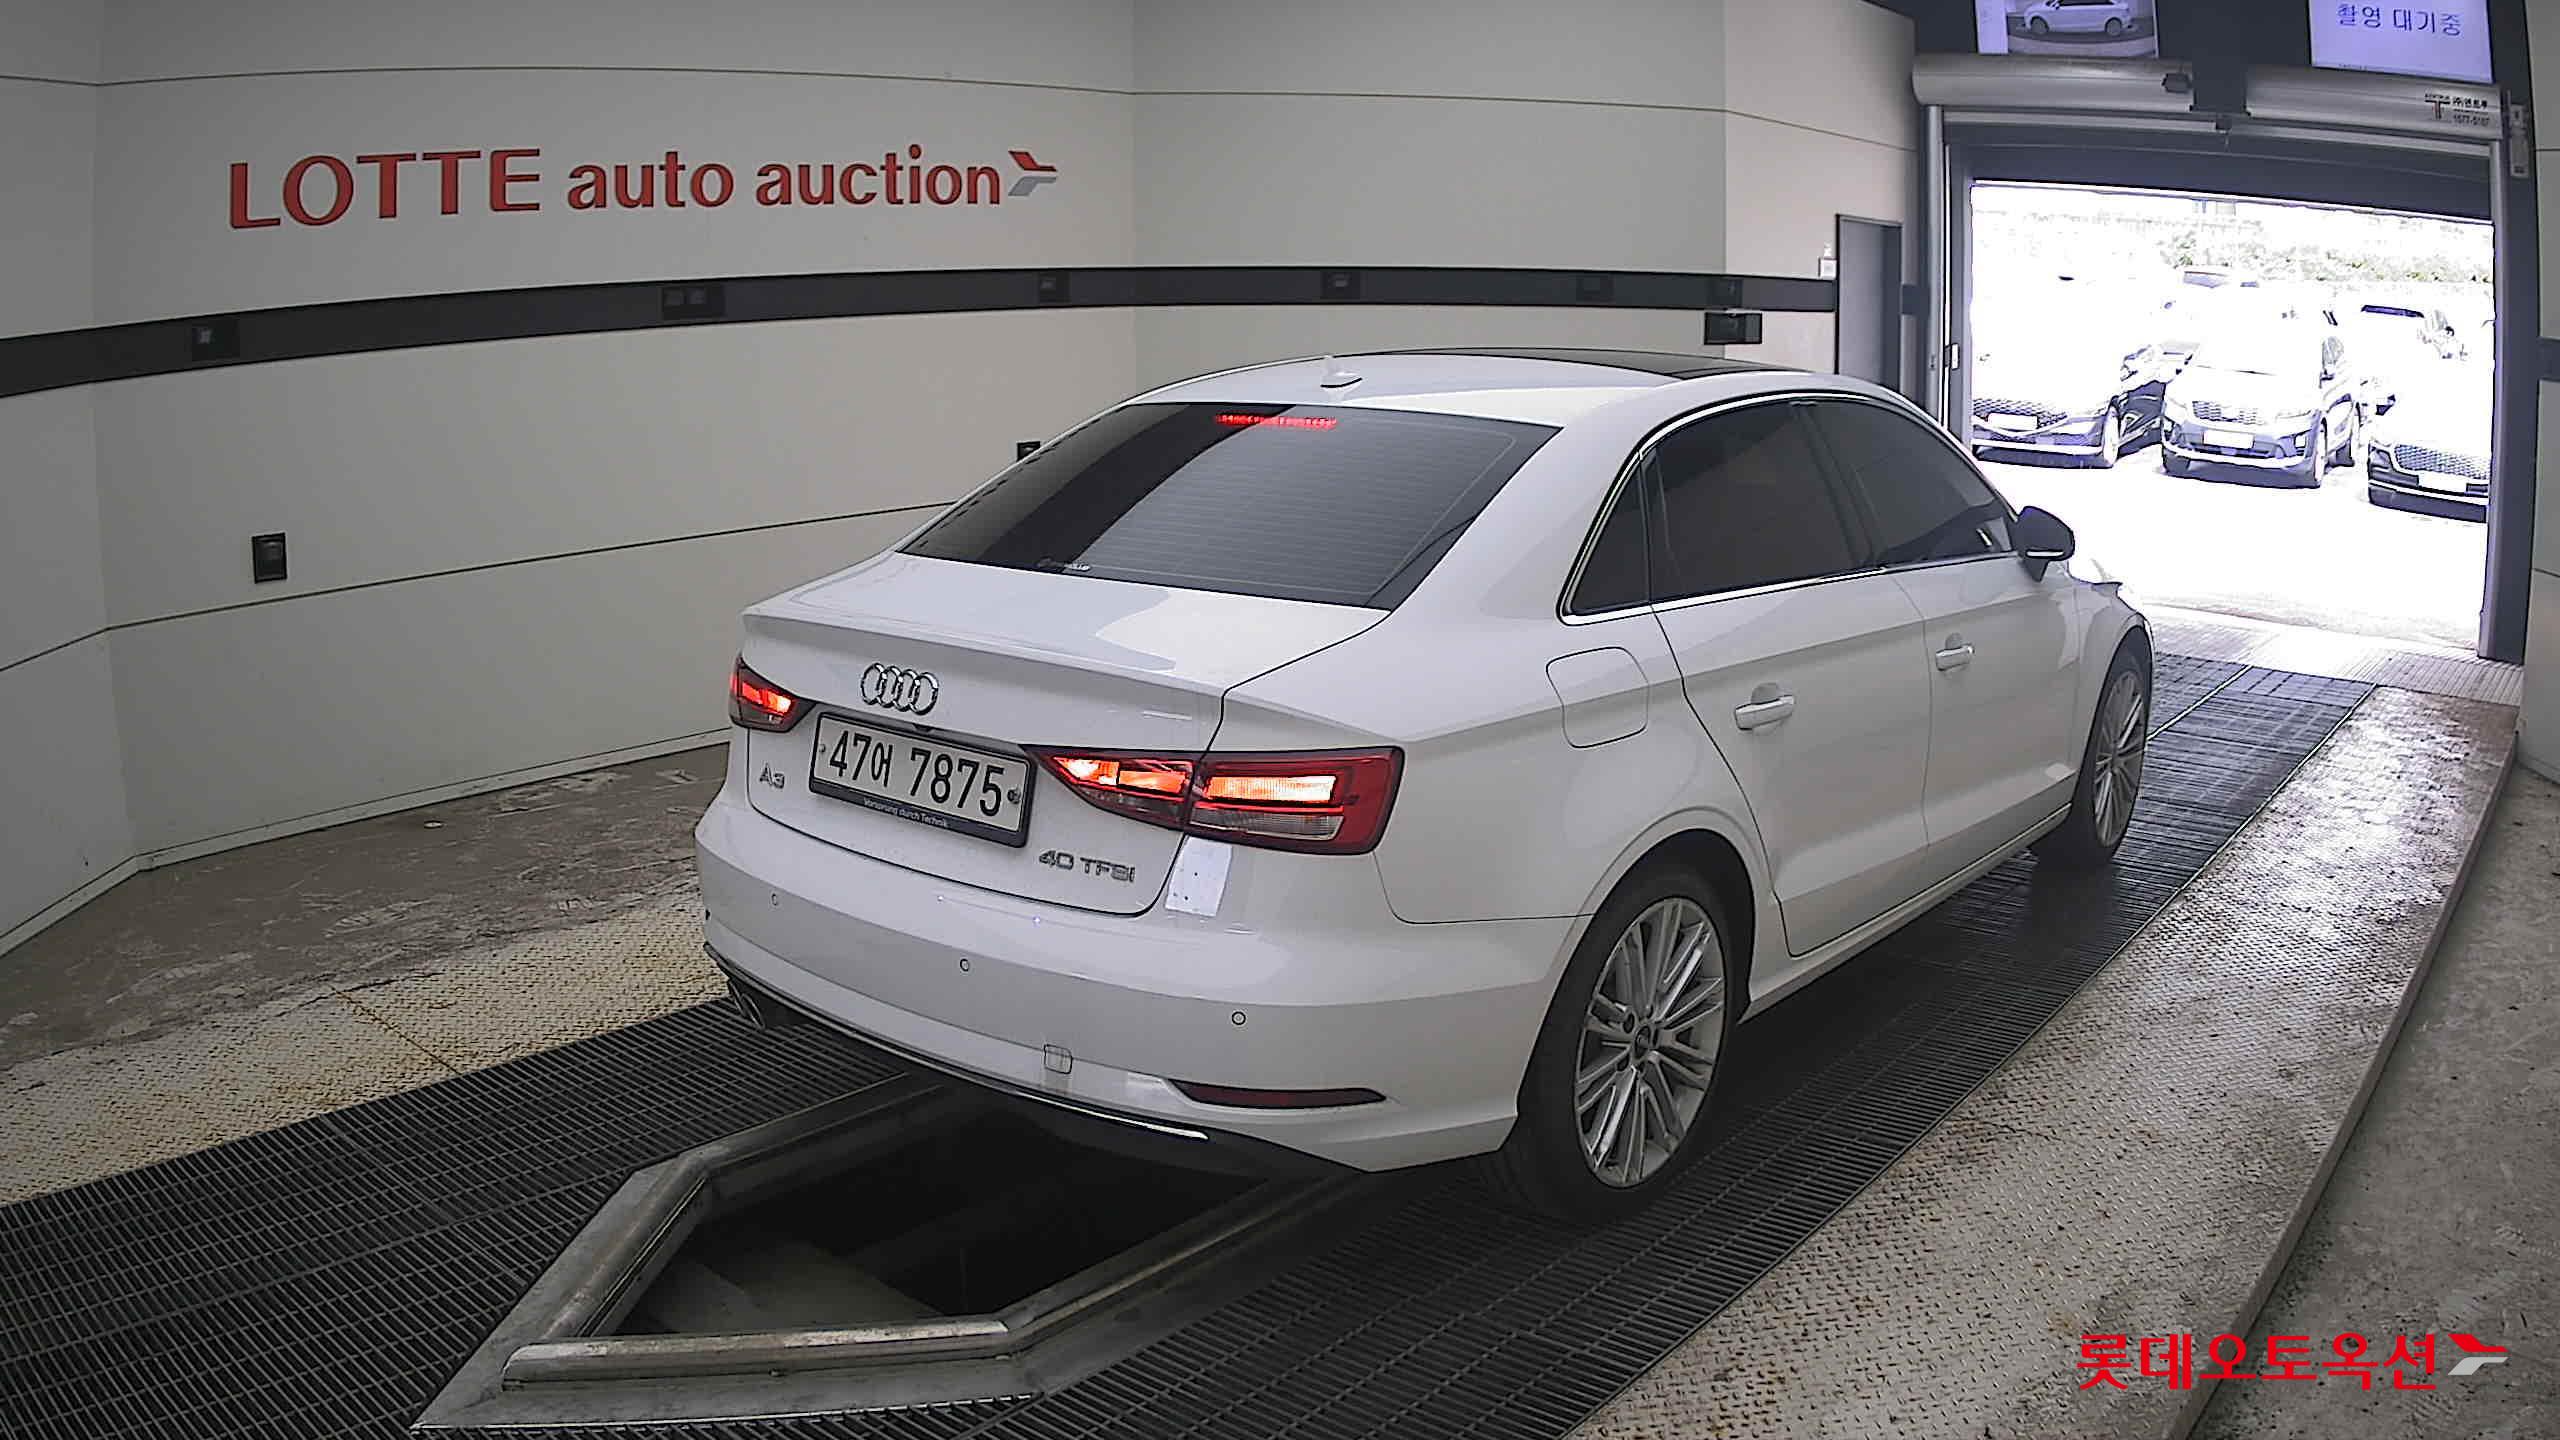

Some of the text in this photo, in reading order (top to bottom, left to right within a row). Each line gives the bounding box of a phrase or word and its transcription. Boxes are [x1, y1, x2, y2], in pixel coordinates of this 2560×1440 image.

[2338, 3, 2462, 37] 촬영 대기중
[229, 143, 1002, 229] LOTTE auto auction
[759, 762, 785, 789] A3
[829, 730, 1005, 817] 47어 7875
[1038, 850, 1075, 871] 40
